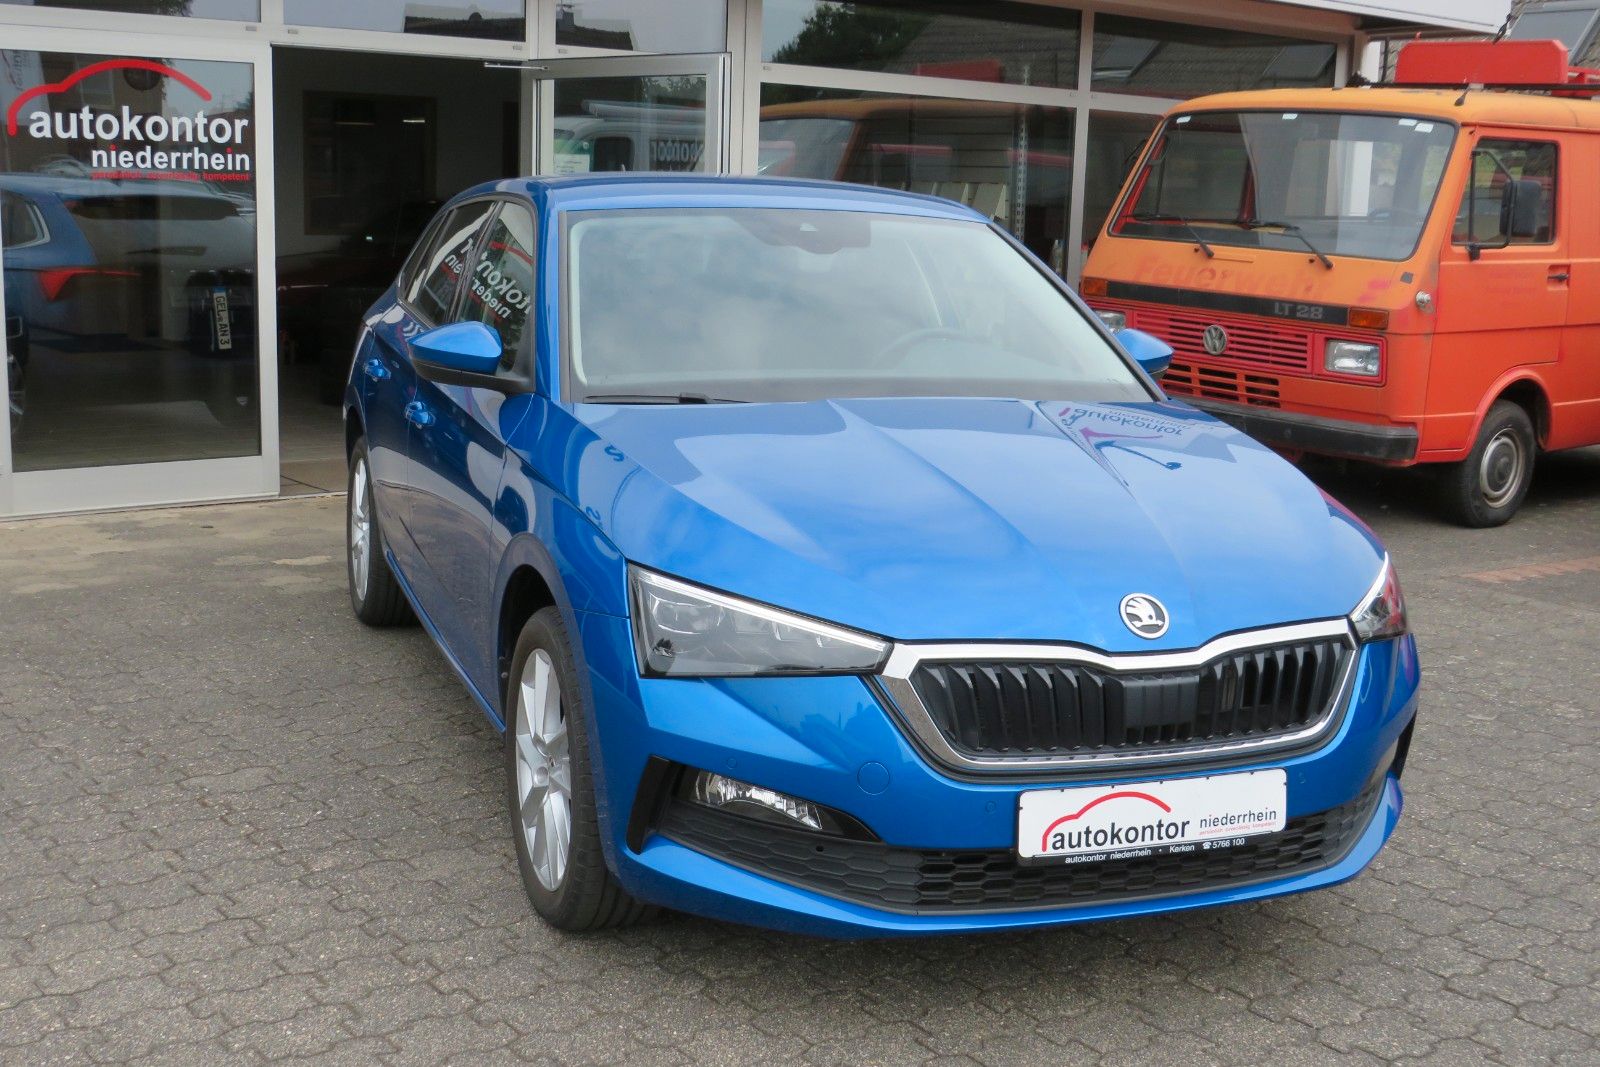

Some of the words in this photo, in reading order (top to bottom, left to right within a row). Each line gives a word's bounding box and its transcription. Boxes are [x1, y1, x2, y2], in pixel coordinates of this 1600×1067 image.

[29, 105, 249, 144] autokontor
[91, 144, 250, 171] niederrhein
[1274, 301, 1295, 316] LT
[1296, 304, 1324, 319] 28
[1052, 819, 1190, 851] autokontor
[1199, 806, 1277, 828] niederrhein
[1065, 853, 1107, 864] autokontor
[1110, 847, 1152, 860] niederrhein
[1169, 843, 1195, 854] Kerken
[1212, 839, 1231, 849] 5766
[1232, 837, 1245, 847] 100
